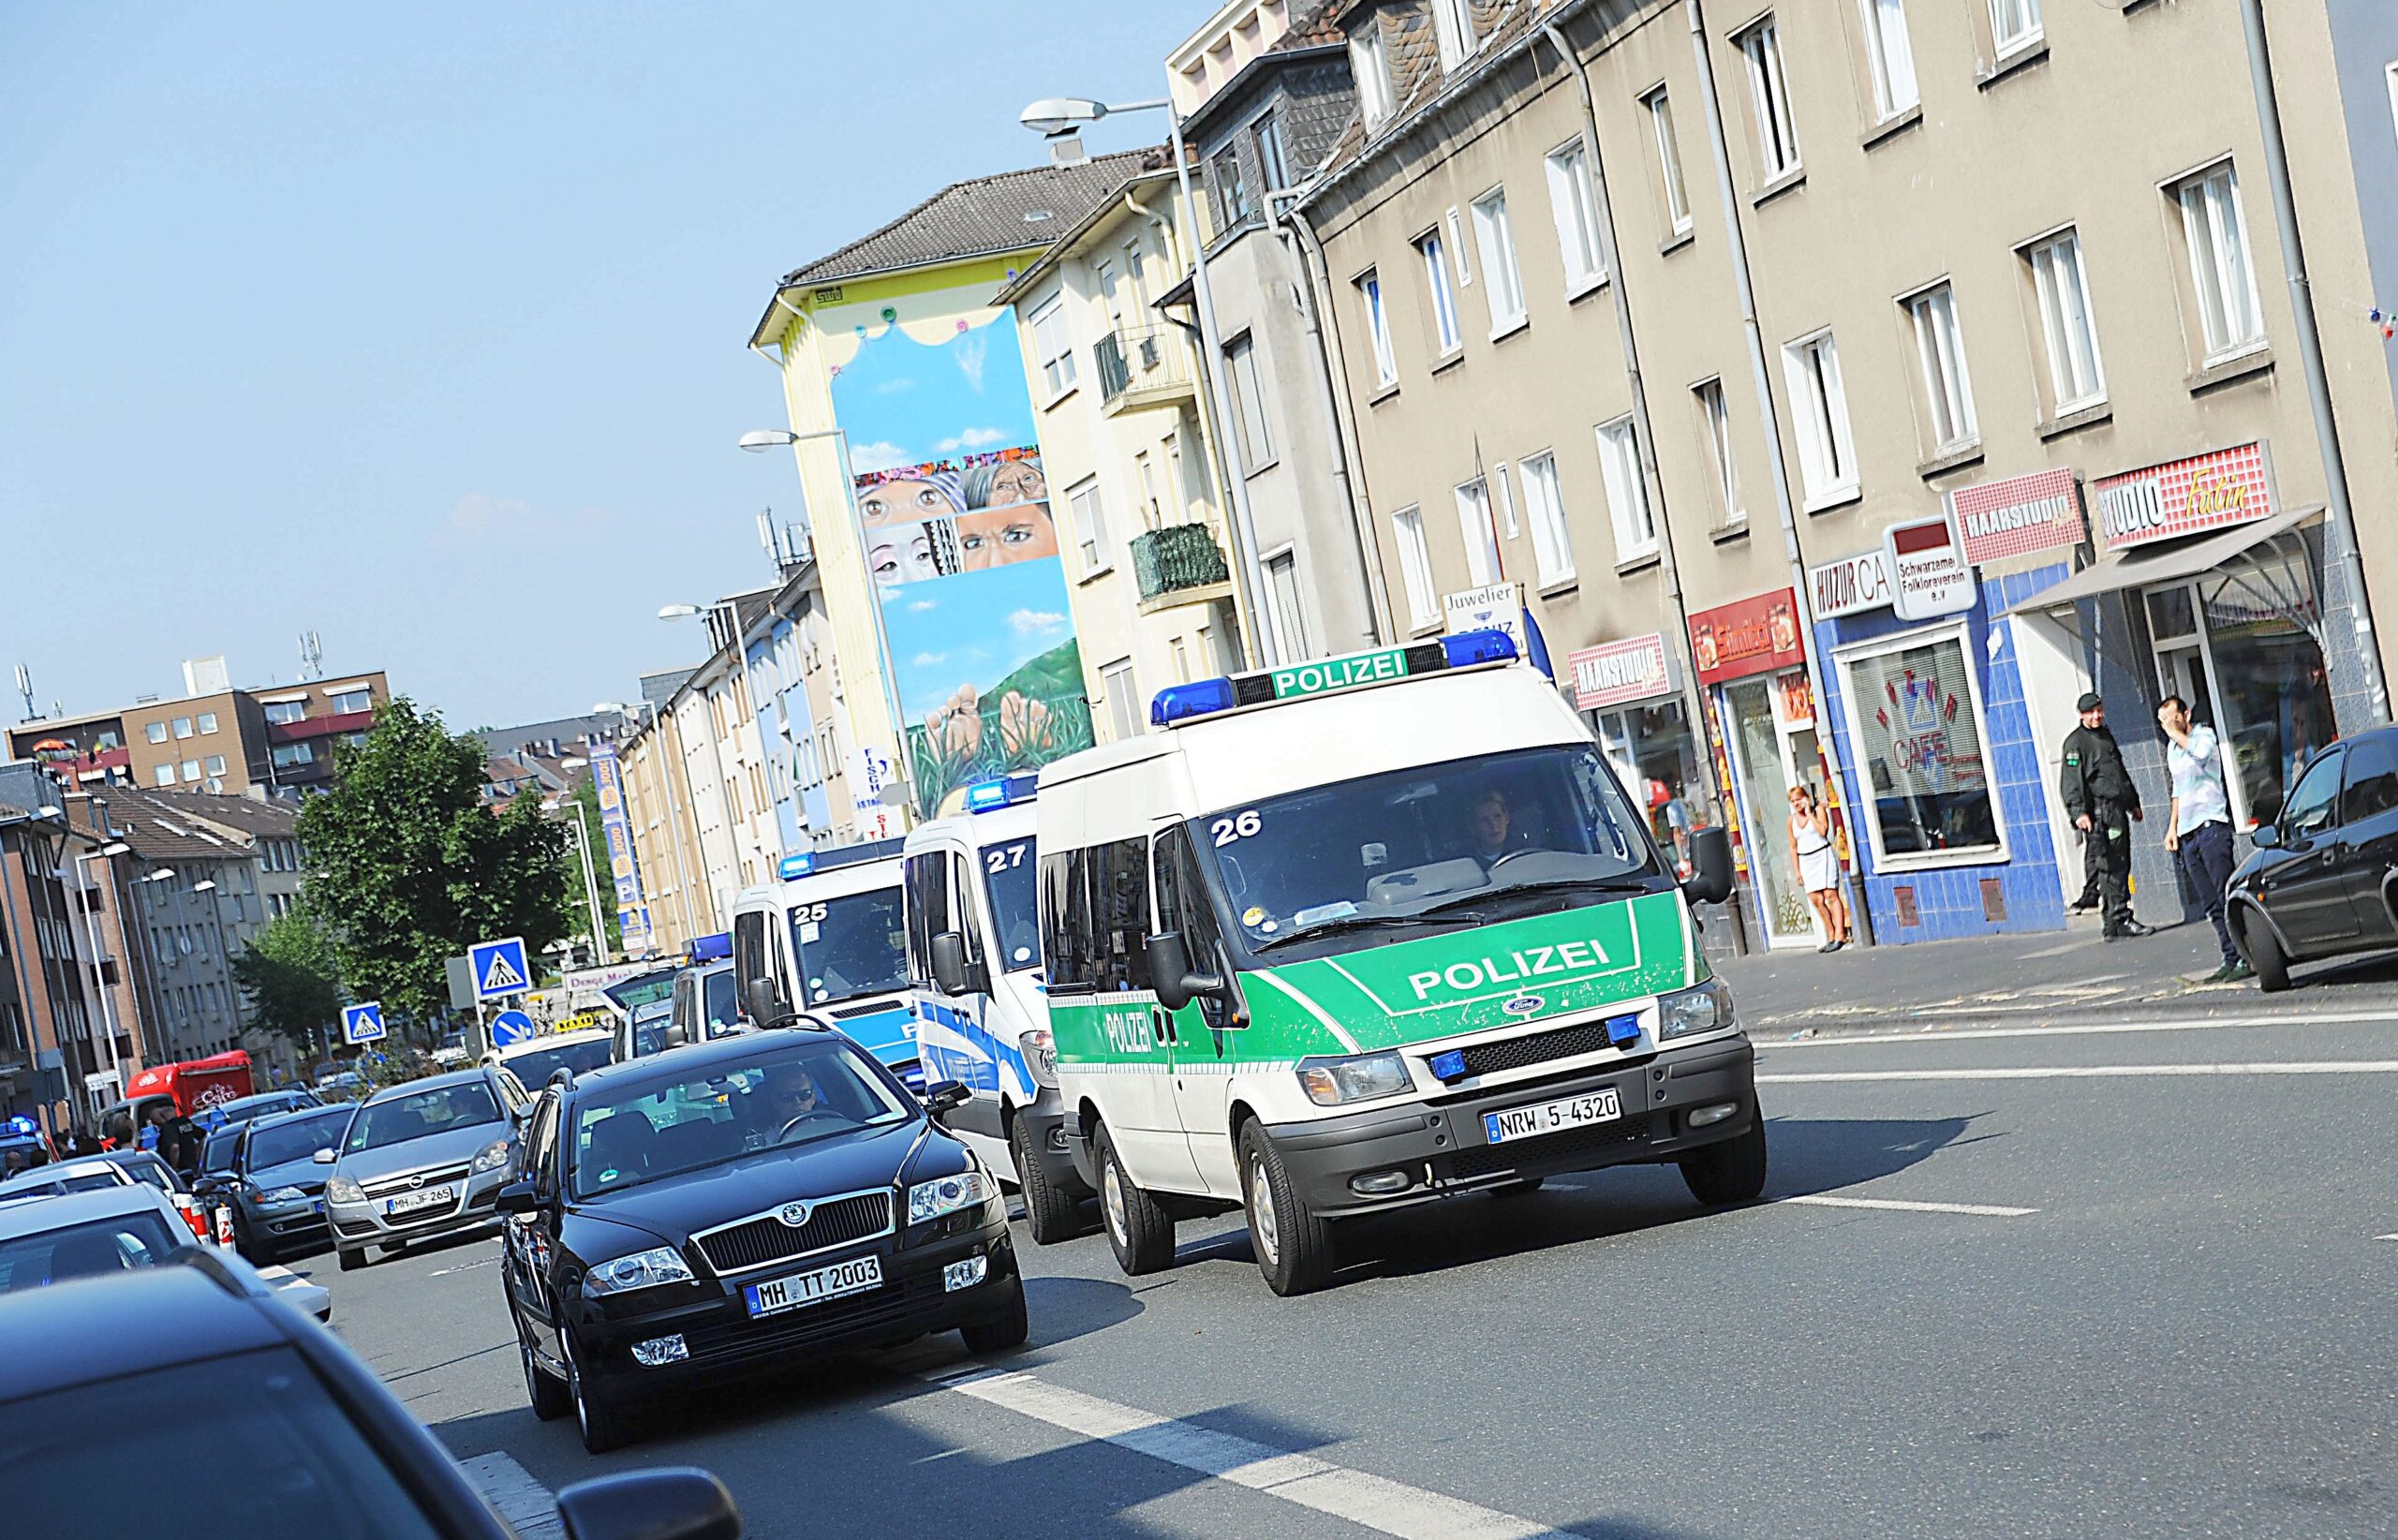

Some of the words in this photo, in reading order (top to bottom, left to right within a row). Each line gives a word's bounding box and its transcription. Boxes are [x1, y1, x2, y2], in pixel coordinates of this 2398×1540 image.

[1965, 494, 2070, 540] HAARSTUDIO
[2097, 477, 2165, 540] STUDIO
[2185, 468, 2248, 518] Fatin
[1448, 587, 1511, 611] Juwelier
[1816, 562, 1857, 614] HUZUR
[1858, 555, 1890, 601] CA
[1902, 571, 1965, 593] Folkloreverein
[1276, 653, 1404, 697] POLIZEI
[1575, 646, 1658, 694] HAARSTUDIO
[864, 748, 881, 792] FISCH
[1893, 732, 1947, 769] CAFE
[1211, 810, 1262, 848] 26
[987, 844, 1026, 874] 27
[794, 902, 828, 925] 25
[1409, 940, 1610, 1000] POLIZEI
[1513, 999, 1535, 1010] Ford
[1105, 1012, 1152, 1053] POLIZEI
[1499, 1110, 1536, 1136] NRW
[1547, 1095, 1616, 1127] 5-4320
[394, 1198, 409, 1209] MH
[415, 1193, 427, 1205] JF
[431, 1188, 450, 1202] 265
[759, 1281, 787, 1308] MH
[799, 1271, 823, 1296] TT
[829, 1258, 879, 1290] 2003
